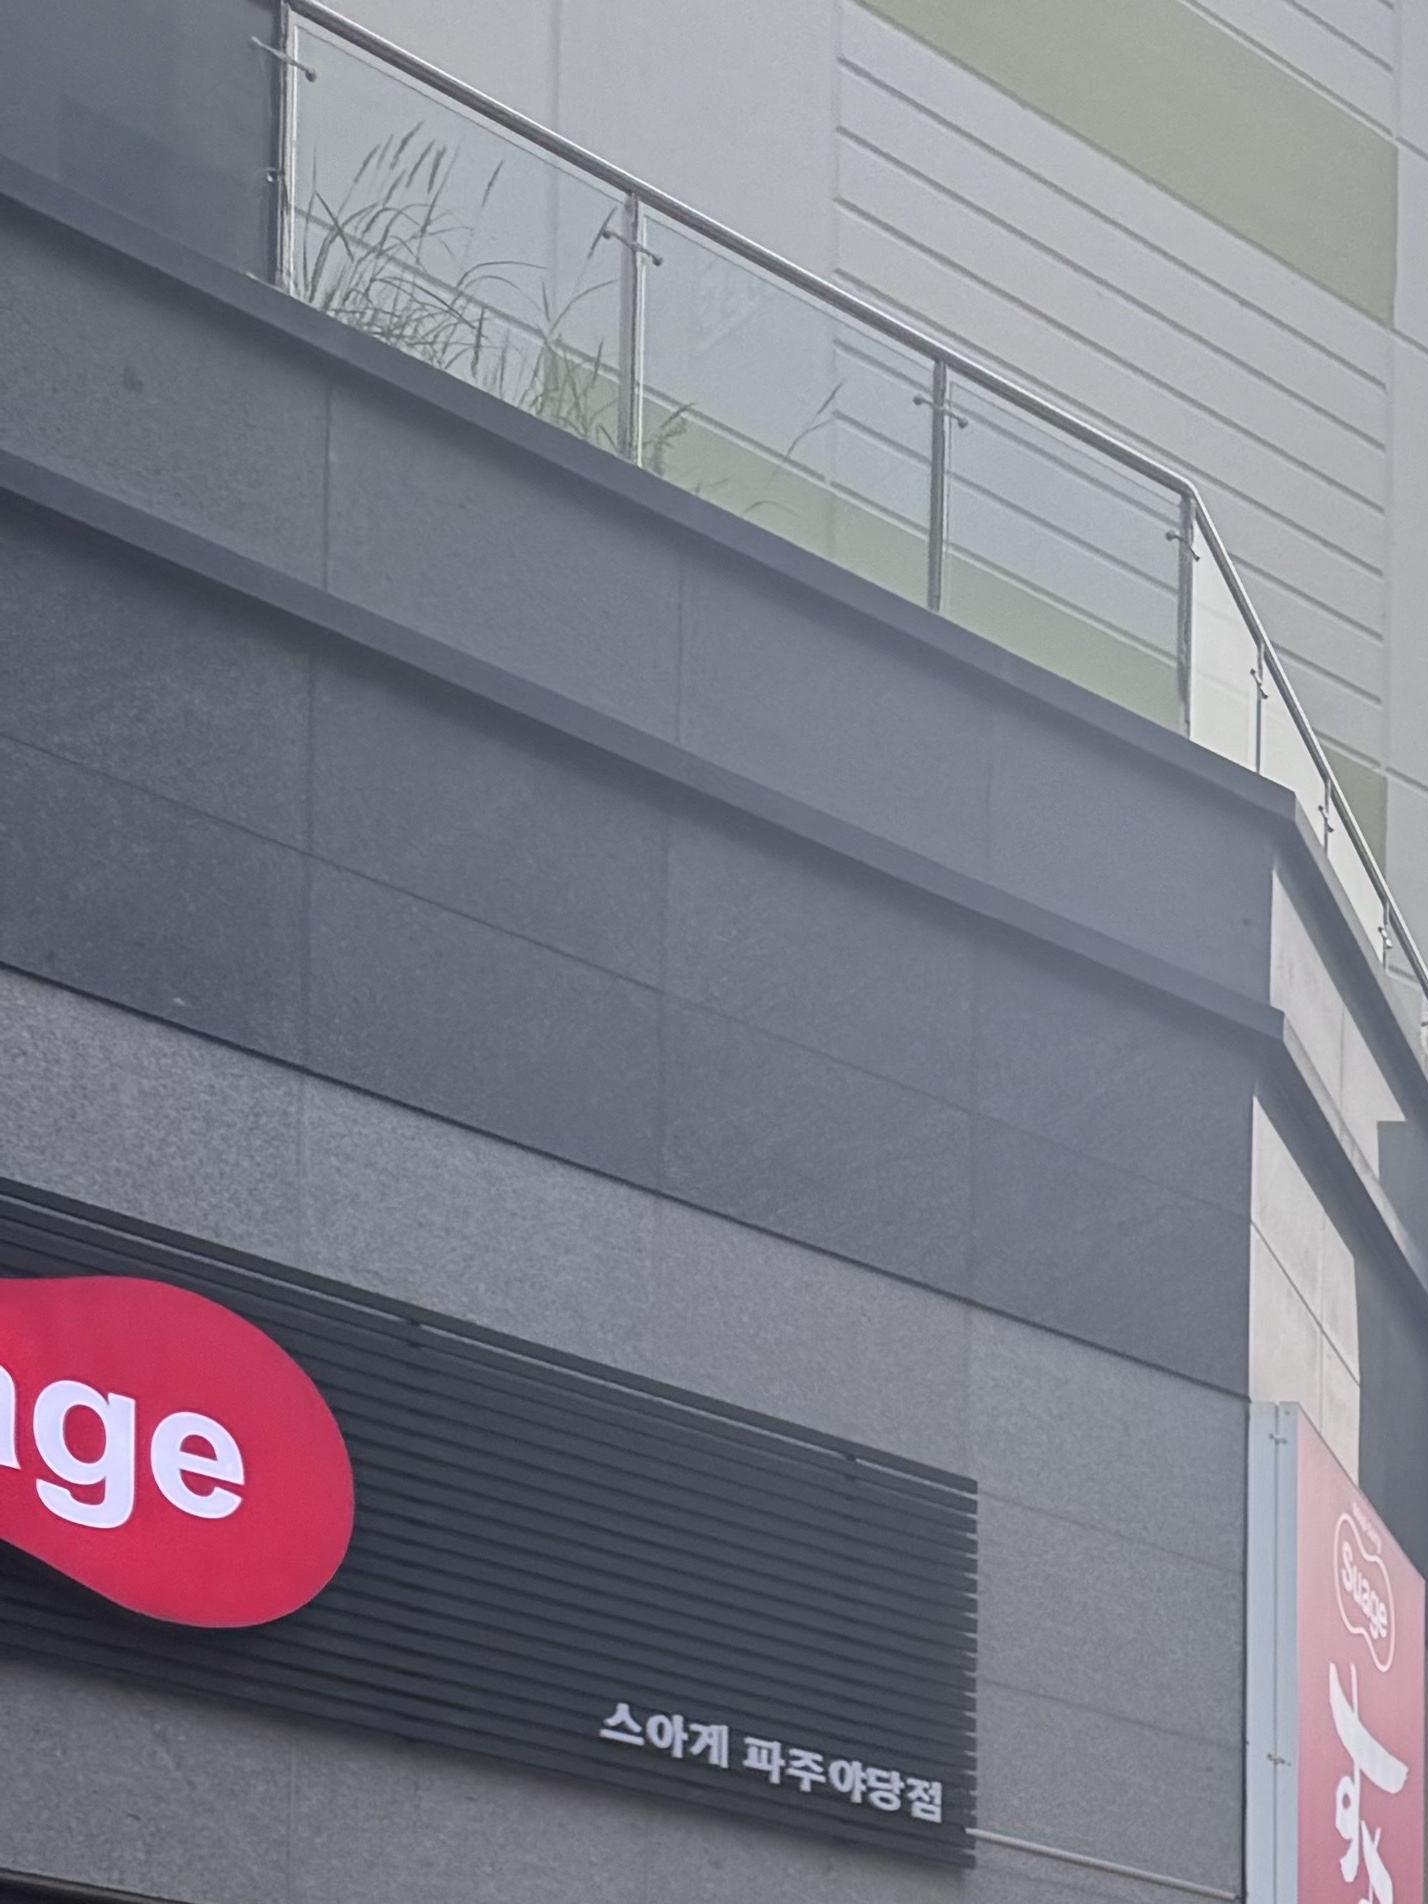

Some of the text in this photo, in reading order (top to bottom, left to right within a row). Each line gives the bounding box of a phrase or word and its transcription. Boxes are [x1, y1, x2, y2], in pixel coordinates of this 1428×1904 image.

[0, 1365, 246, 1529] ge
[1341, 1541, 1388, 1639] Suage
[599, 1703, 943, 1824] 스아게 파주야당점
